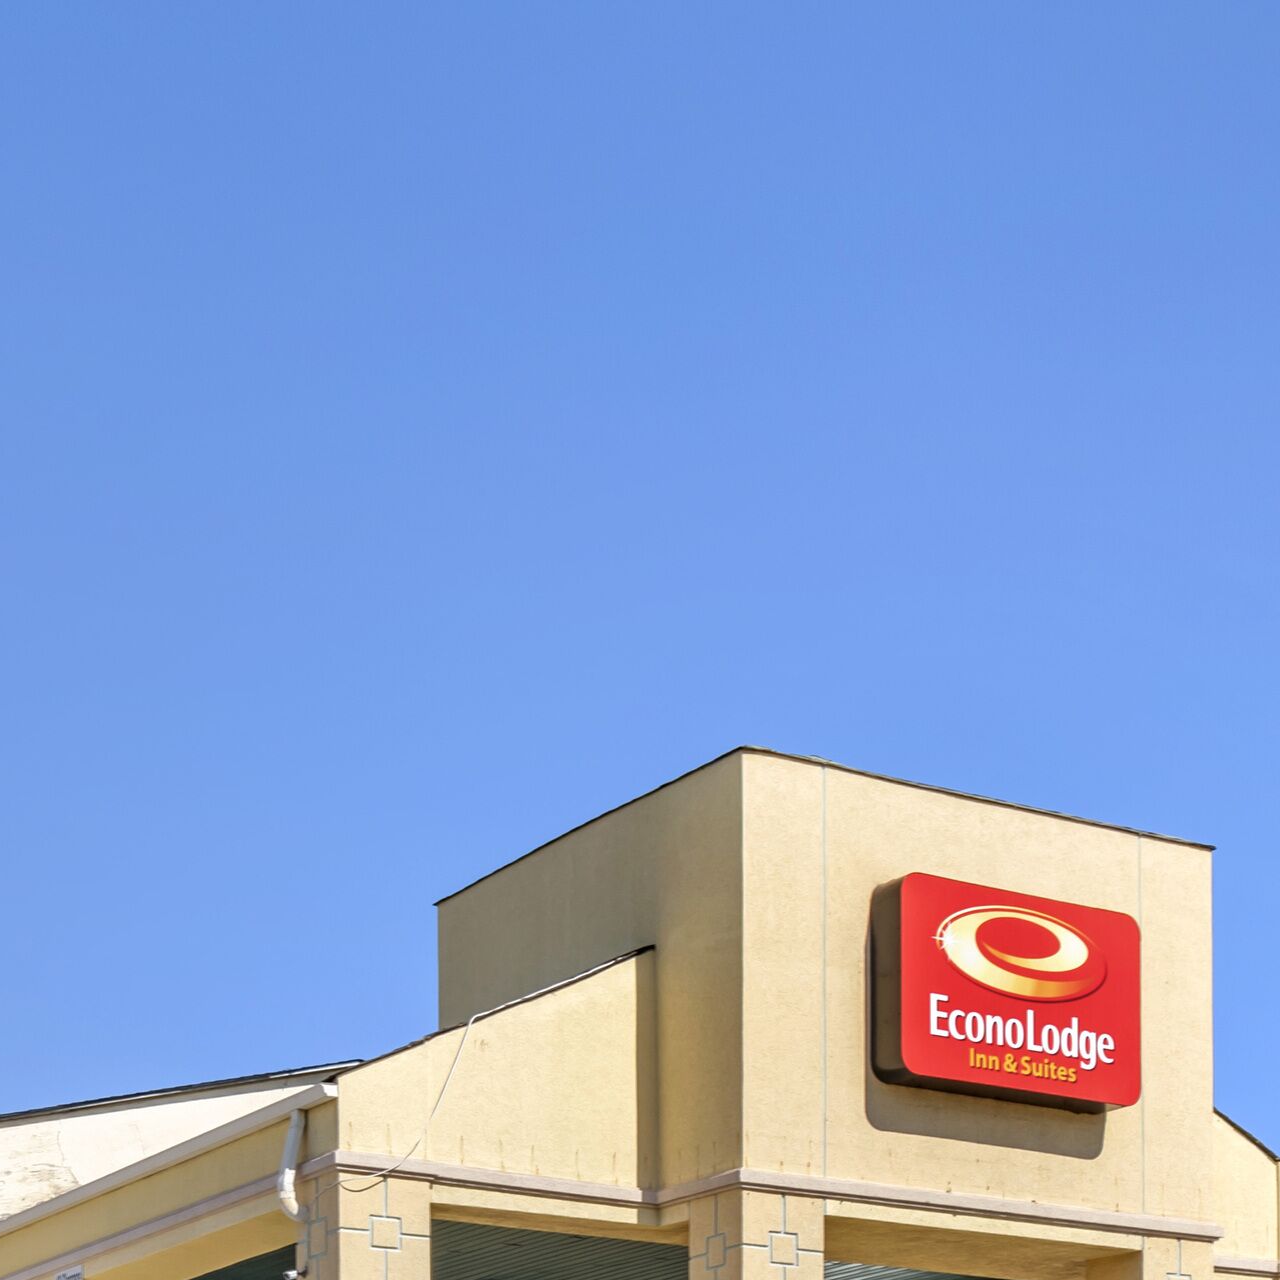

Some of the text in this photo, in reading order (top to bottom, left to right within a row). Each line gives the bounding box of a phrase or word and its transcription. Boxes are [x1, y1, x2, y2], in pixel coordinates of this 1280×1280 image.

[969, 1048, 1077, 1082] Inn & Suites
